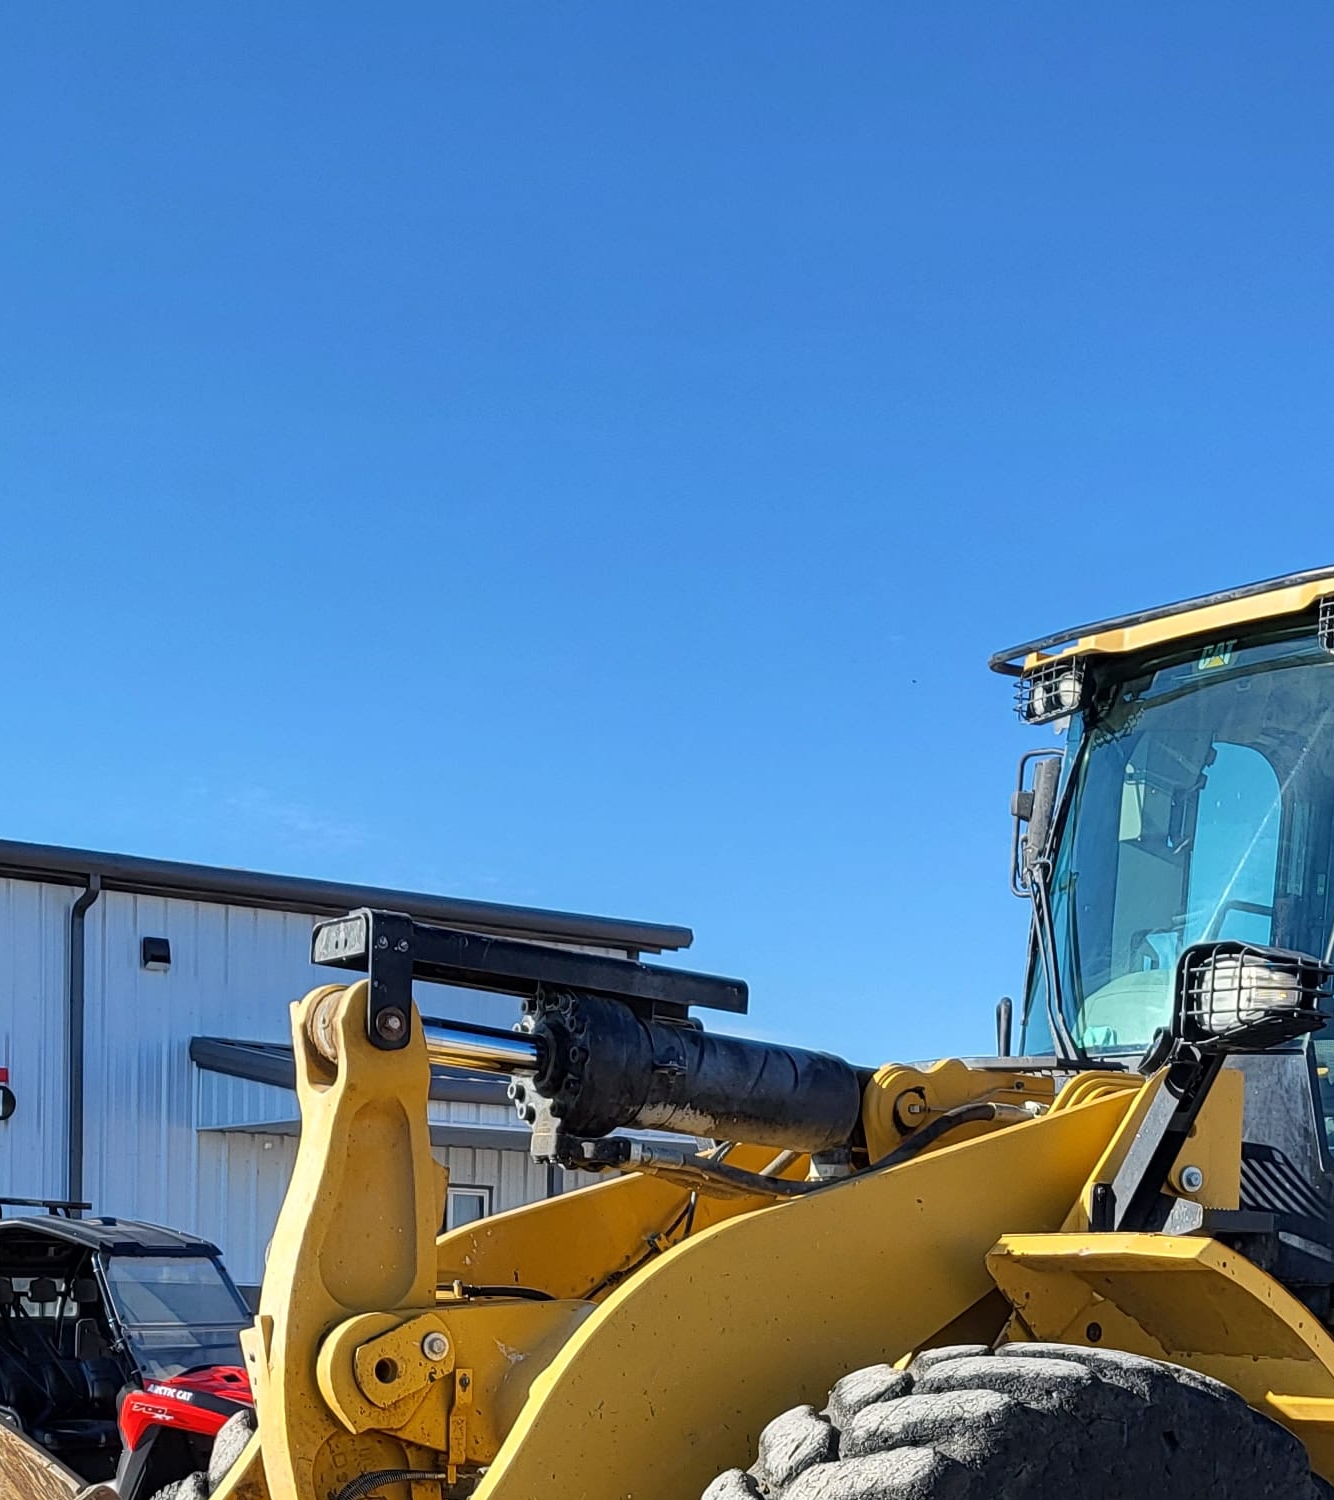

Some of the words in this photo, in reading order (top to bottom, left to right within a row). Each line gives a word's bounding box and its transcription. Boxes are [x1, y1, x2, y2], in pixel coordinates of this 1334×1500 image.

[1198, 639, 1238, 670] CAT
[147, 1383, 176, 1398] ARCTIC
[176, 1388, 193, 1401] CAT
